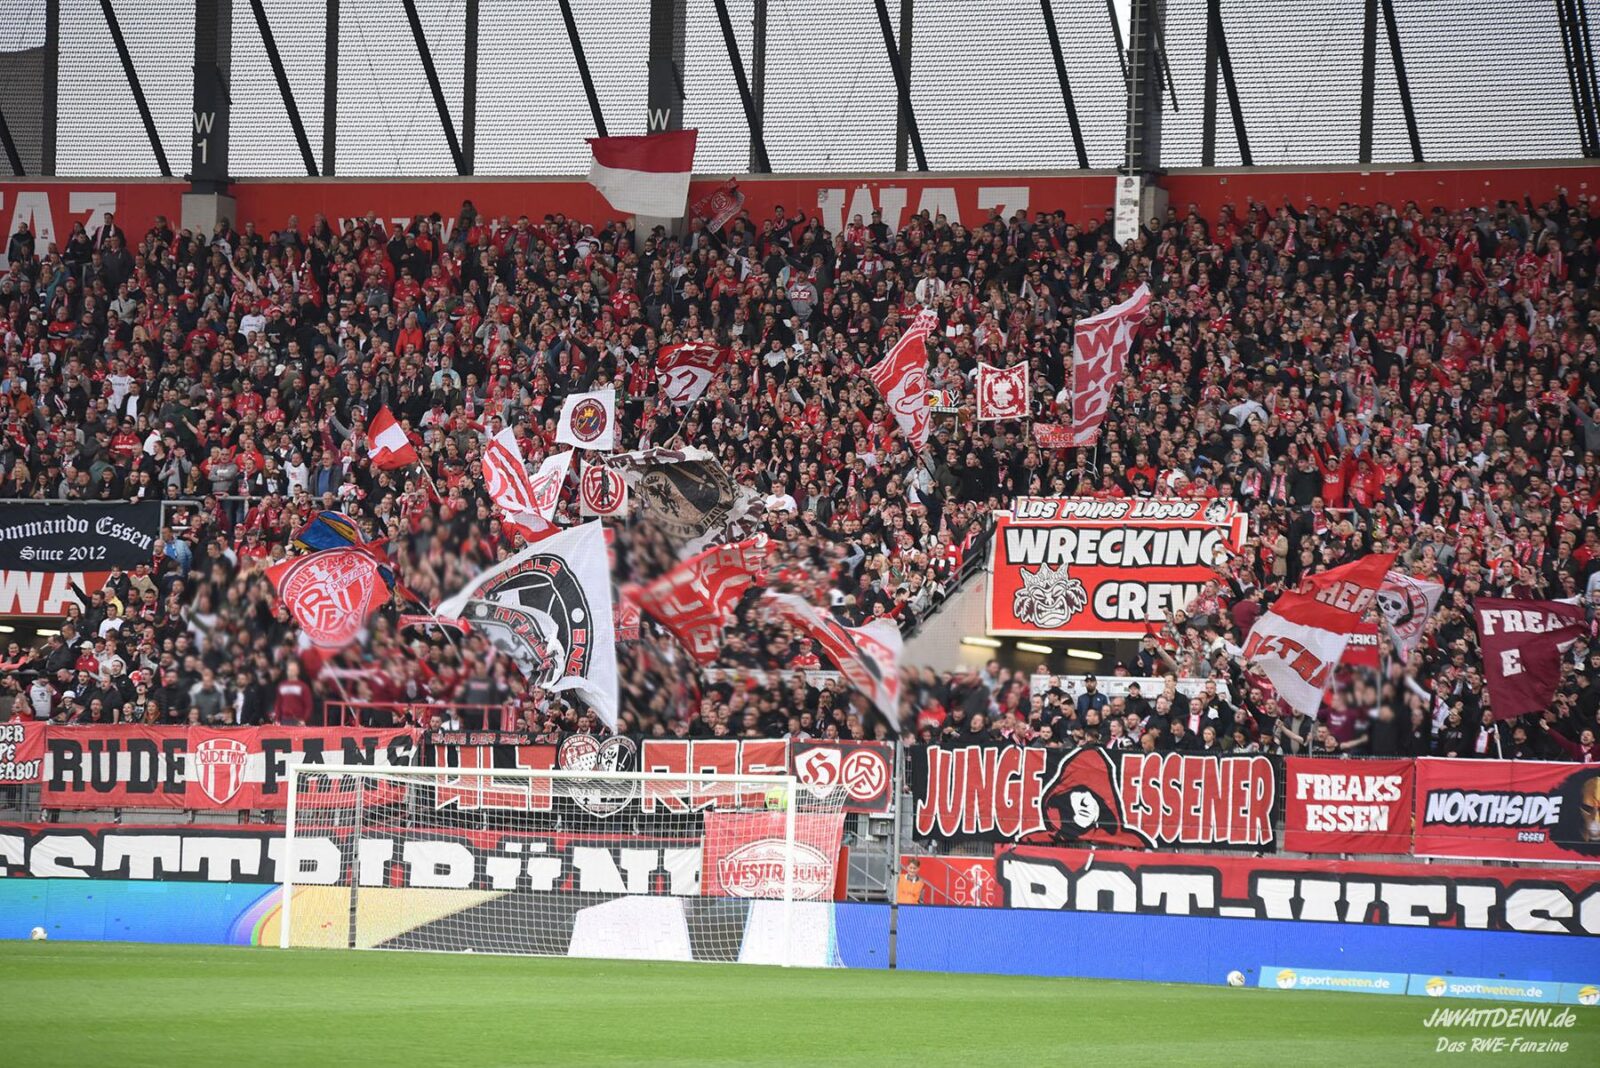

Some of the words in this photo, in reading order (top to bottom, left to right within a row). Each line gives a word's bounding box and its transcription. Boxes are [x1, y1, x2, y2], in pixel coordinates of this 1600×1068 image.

[648, 108, 671, 131] W
[0, 191, 117, 268] AZ
[1017, 501, 1058, 518] LOS
[95, 515, 152, 549] Essen
[1006, 527, 1231, 566] WRECKING
[19, 546, 64, 561] Since
[67, 546, 107, 560] 2012
[0, 570, 128, 613] WA
[48, 737, 188, 793] RUDE
[261, 735, 414, 794] FANS
[199, 750, 224, 763] RUDE
[915, 744, 1047, 837] JUNGE
[1119, 752, 1275, 845] ESSENER
[1295, 773, 1402, 802] FREAKS
[1305, 804, 1389, 832] ESSEN
[1426, 792, 1563, 826] NORTHSIDE
[718, 859, 831, 890] WESTTRBÜNE
[1002, 858, 1600, 935] ROT-WEIS
[1299, 973, 1391, 990] sportwetten.de
[1449, 983, 1543, 999] sportwetten.de
